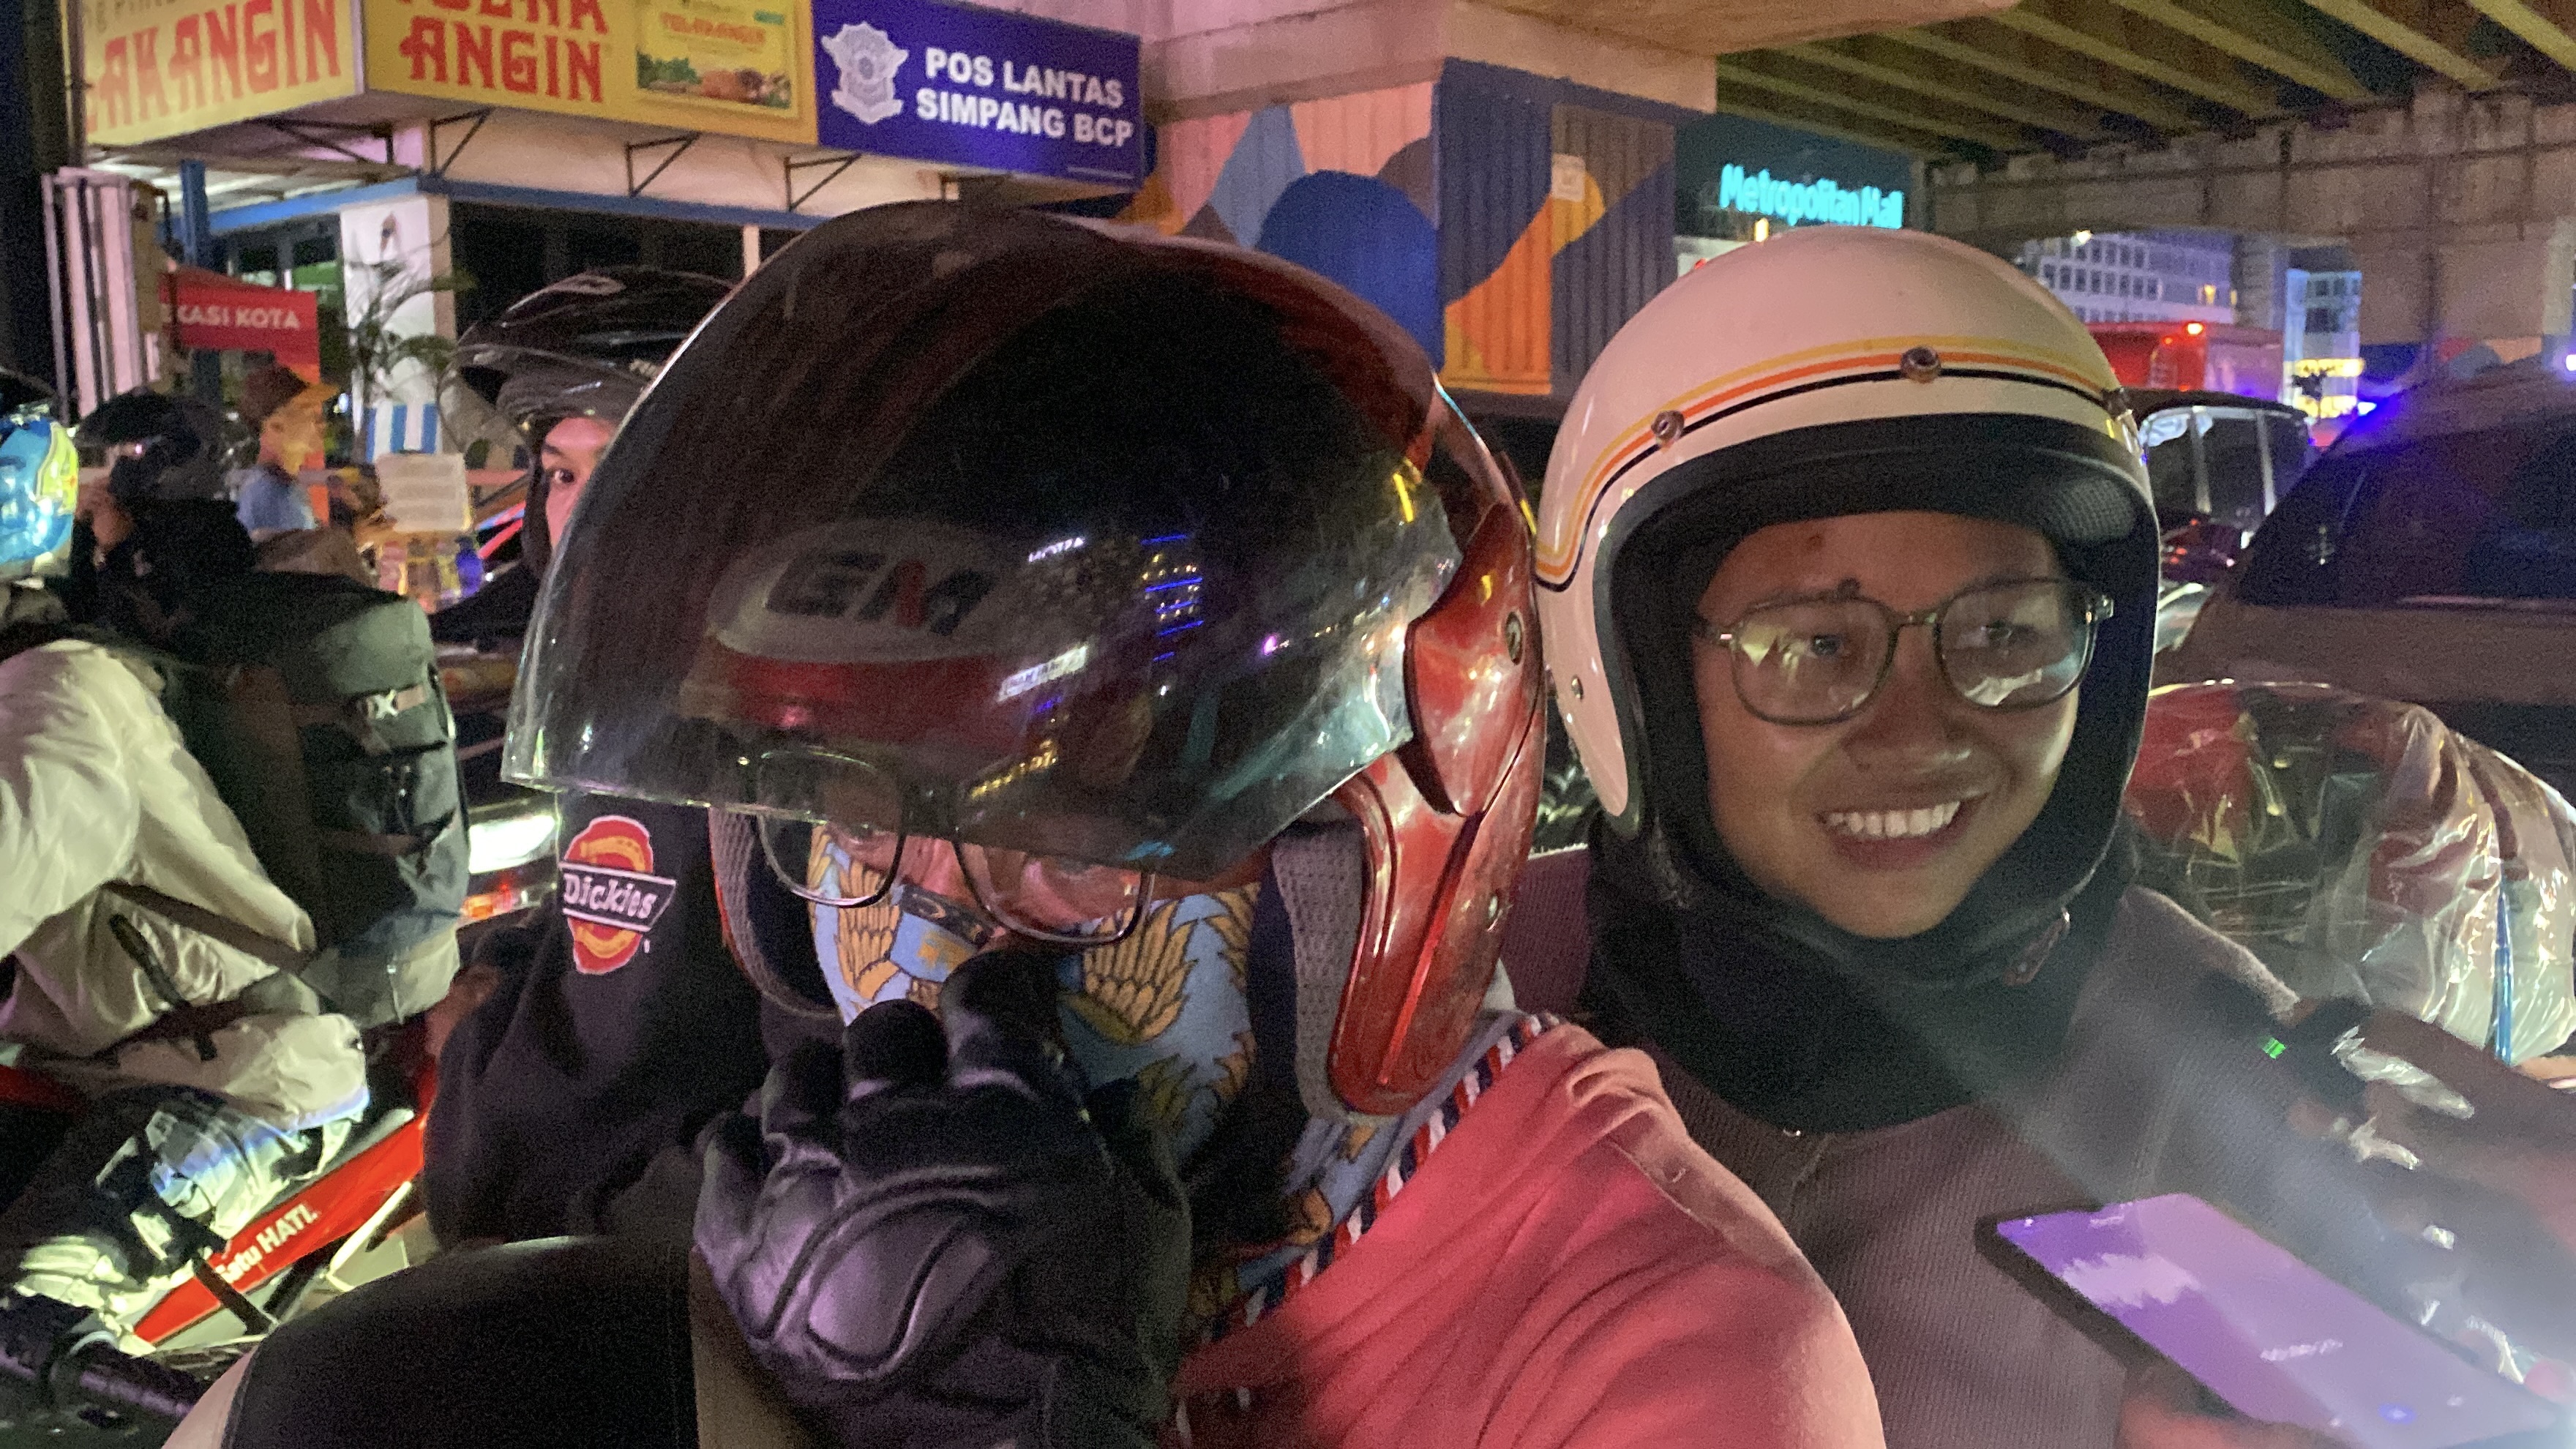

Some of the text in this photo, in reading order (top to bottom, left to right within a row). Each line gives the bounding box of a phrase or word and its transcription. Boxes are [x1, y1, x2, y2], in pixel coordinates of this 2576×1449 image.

[168, 0, 342, 113] ANGIN
[399, 15, 602, 103] ANGIN
[925, 47, 1124, 109] POS LANTAS
[916, 88, 1134, 146] SIMPANG BCP
[234, 306, 300, 329] KOTA
[563, 873, 658, 919] Dickies
